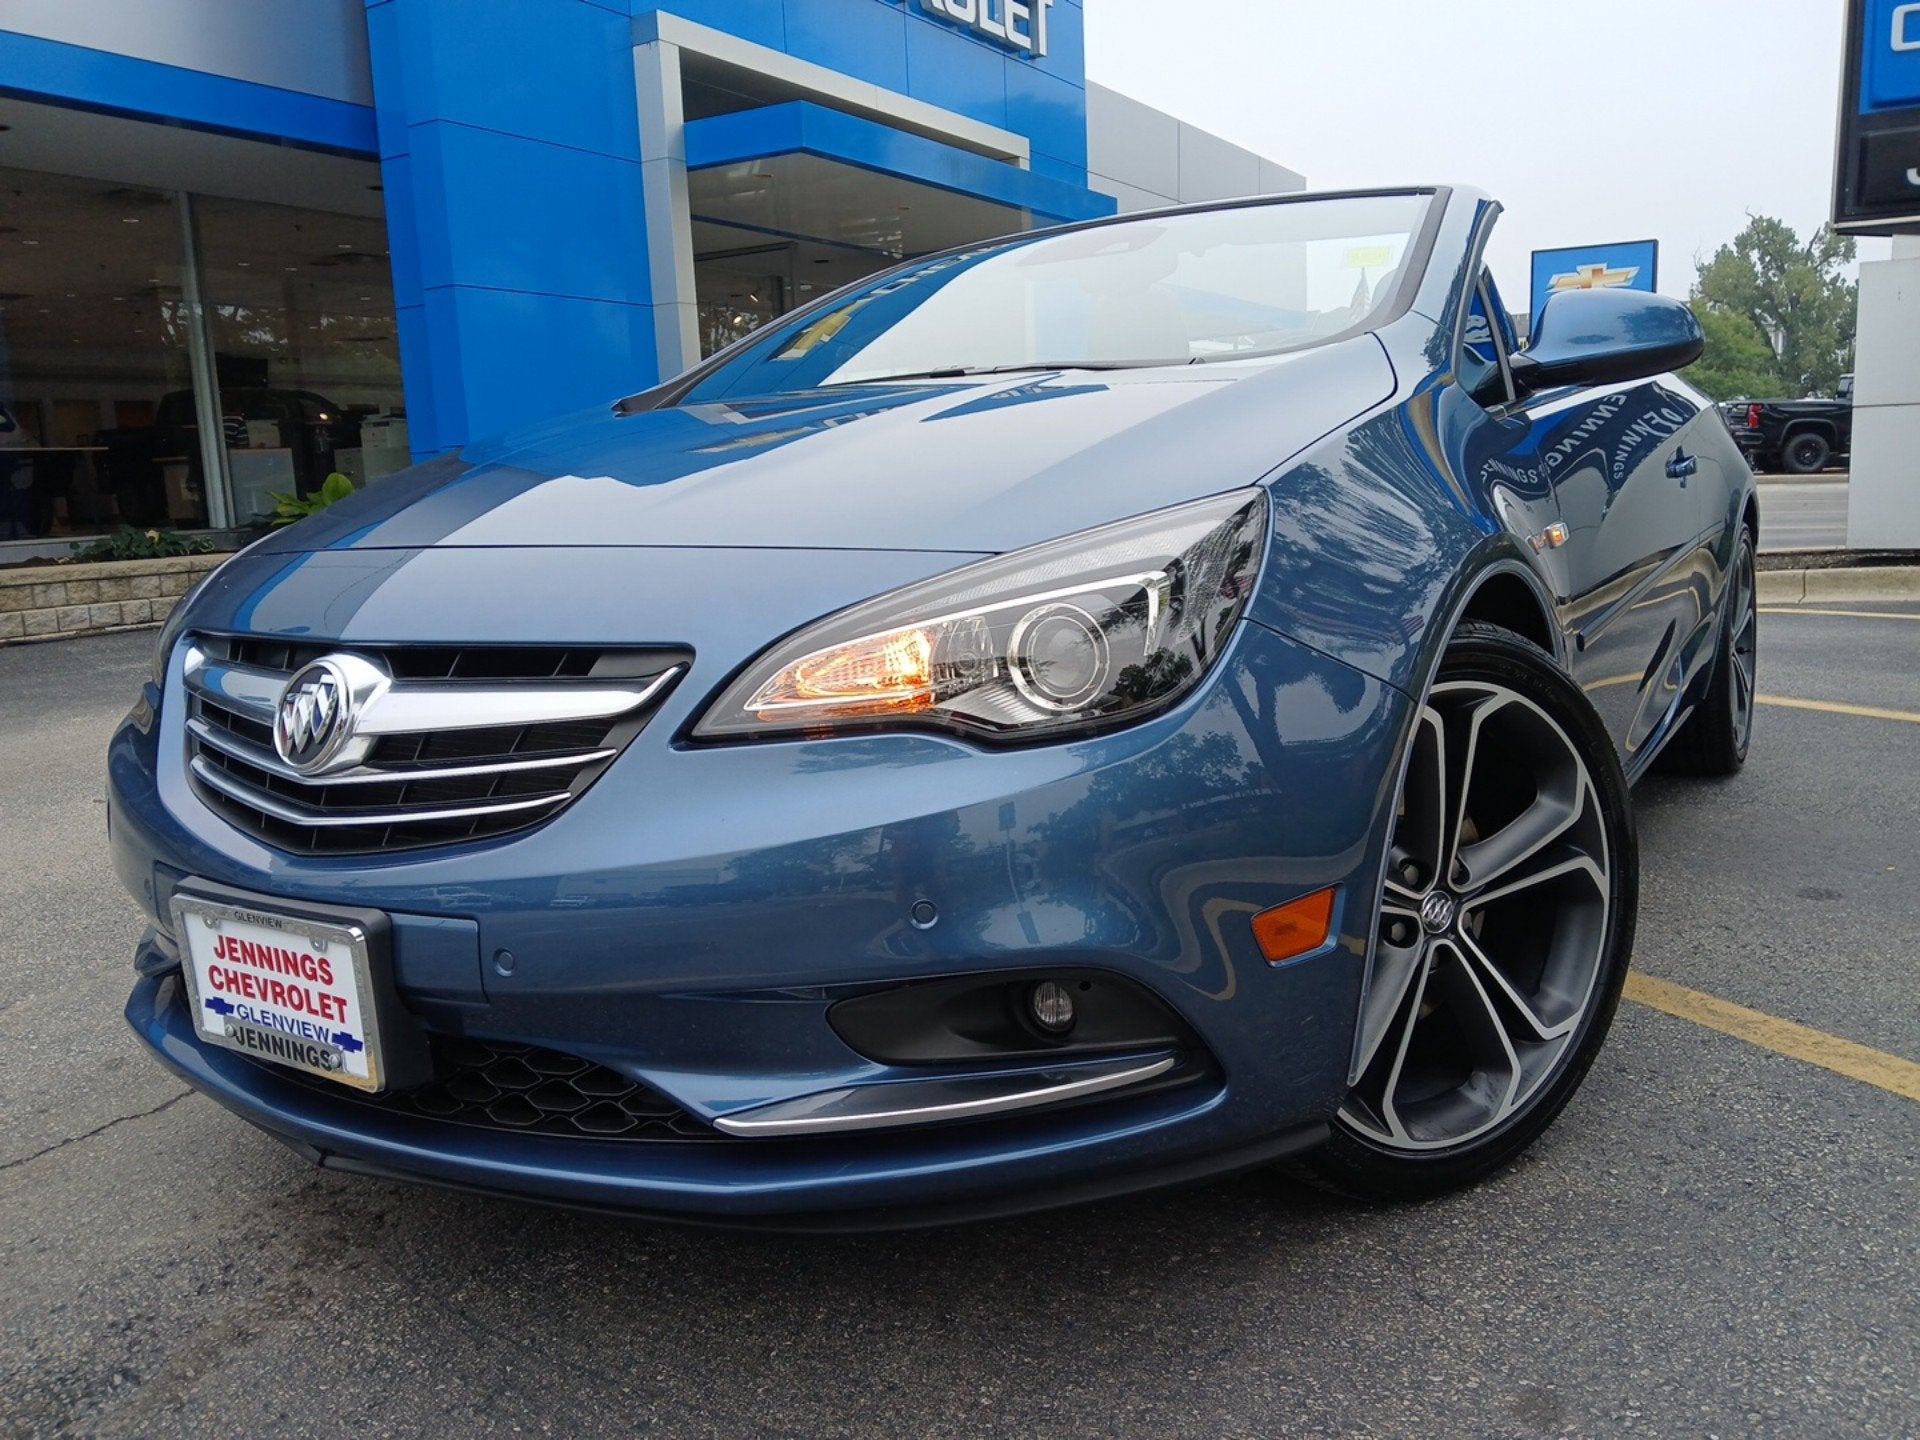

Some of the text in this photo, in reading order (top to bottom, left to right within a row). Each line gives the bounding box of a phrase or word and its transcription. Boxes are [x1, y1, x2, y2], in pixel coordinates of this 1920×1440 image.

[234, 911, 282, 929] GLENVIEW
[213, 934, 334, 986] JENNINGS
[208, 965, 347, 1024] CHEVROLET
[236, 1003, 331, 1043] GLENVIEW
[235, 1026, 333, 1072] JENNINGS
